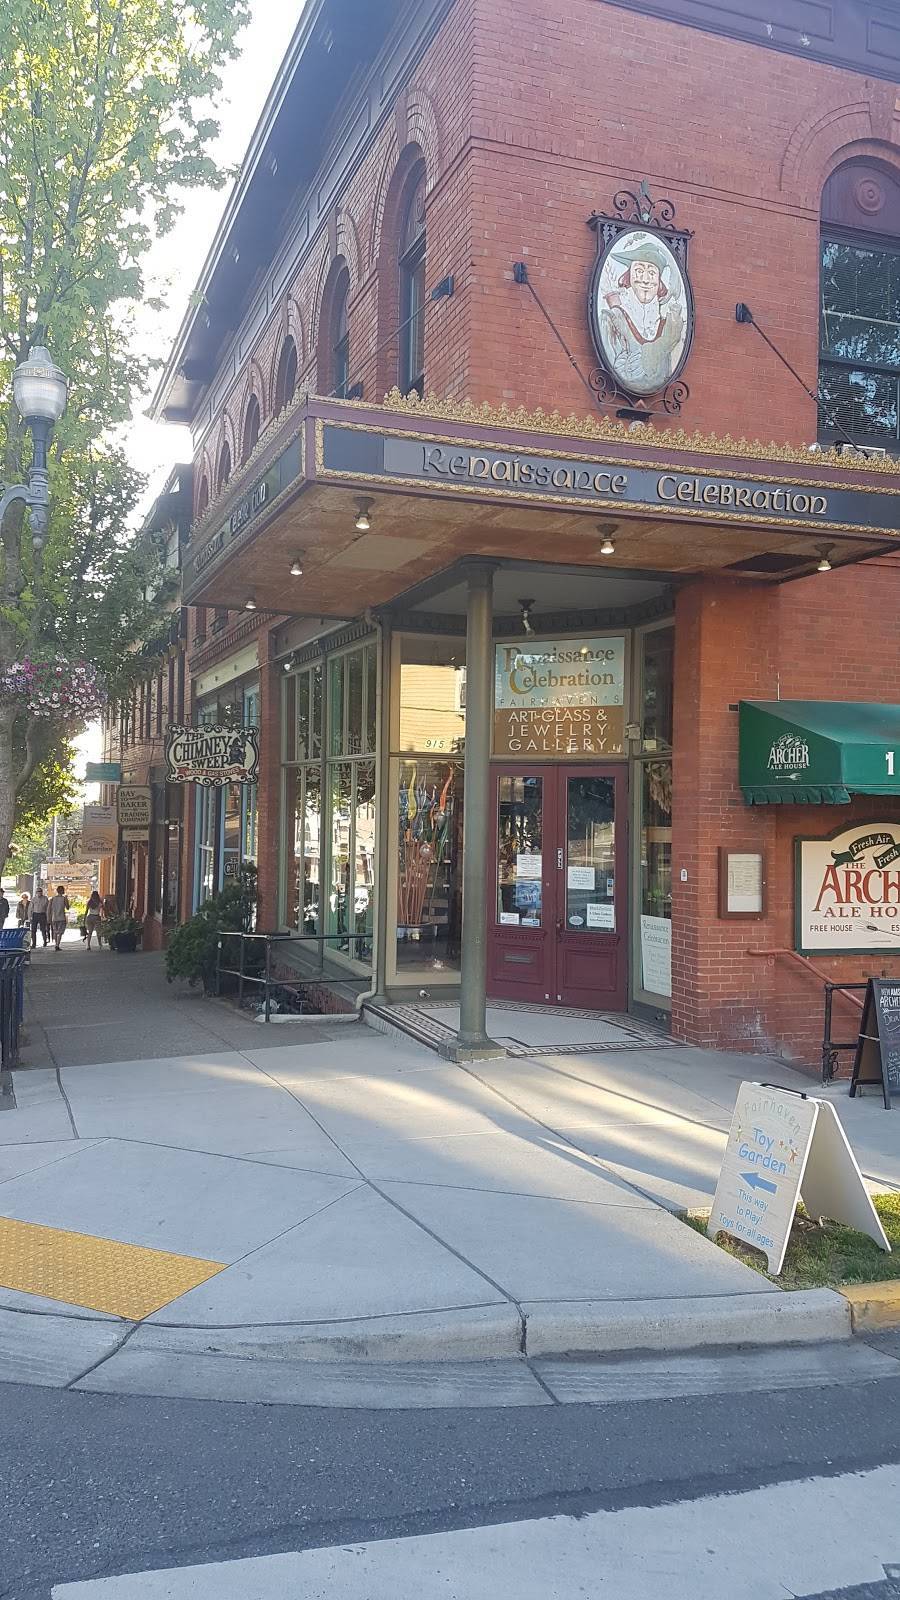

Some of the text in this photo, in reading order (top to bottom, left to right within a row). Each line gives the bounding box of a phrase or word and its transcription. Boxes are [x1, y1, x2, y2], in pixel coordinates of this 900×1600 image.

[421, 446, 629, 494] Renaissance
[509, 664, 615, 694] Celebration
[185, 732, 205, 742] THE
[508, 723, 608, 737] JEWELRY
[173, 736, 233, 763] CHIMNEY
[425, 739, 445, 749] 915
[508, 738, 608, 751] GALLERY
[191, 755, 230, 769] SWEEP
[767, 745, 810, 769] ARCHER
[850, 834, 891, 854] Fresh Air
[845, 862, 866, 870] THE
[877, 848, 900, 867] Fresh
[823, 906, 861, 918] ALE
[809, 924, 829, 932] FREE
[830, 924, 853, 932] HOUSE
[753, 1127, 775, 1152] Toy
[738, 1142, 787, 1175] Garden
[736, 1204, 744, 1216] to
[738, 1188, 769, 1213] This way
[719, 1212, 734, 1228] Toys
[735, 1220, 746, 1232] for
[756, 1232, 775, 1248] ages
